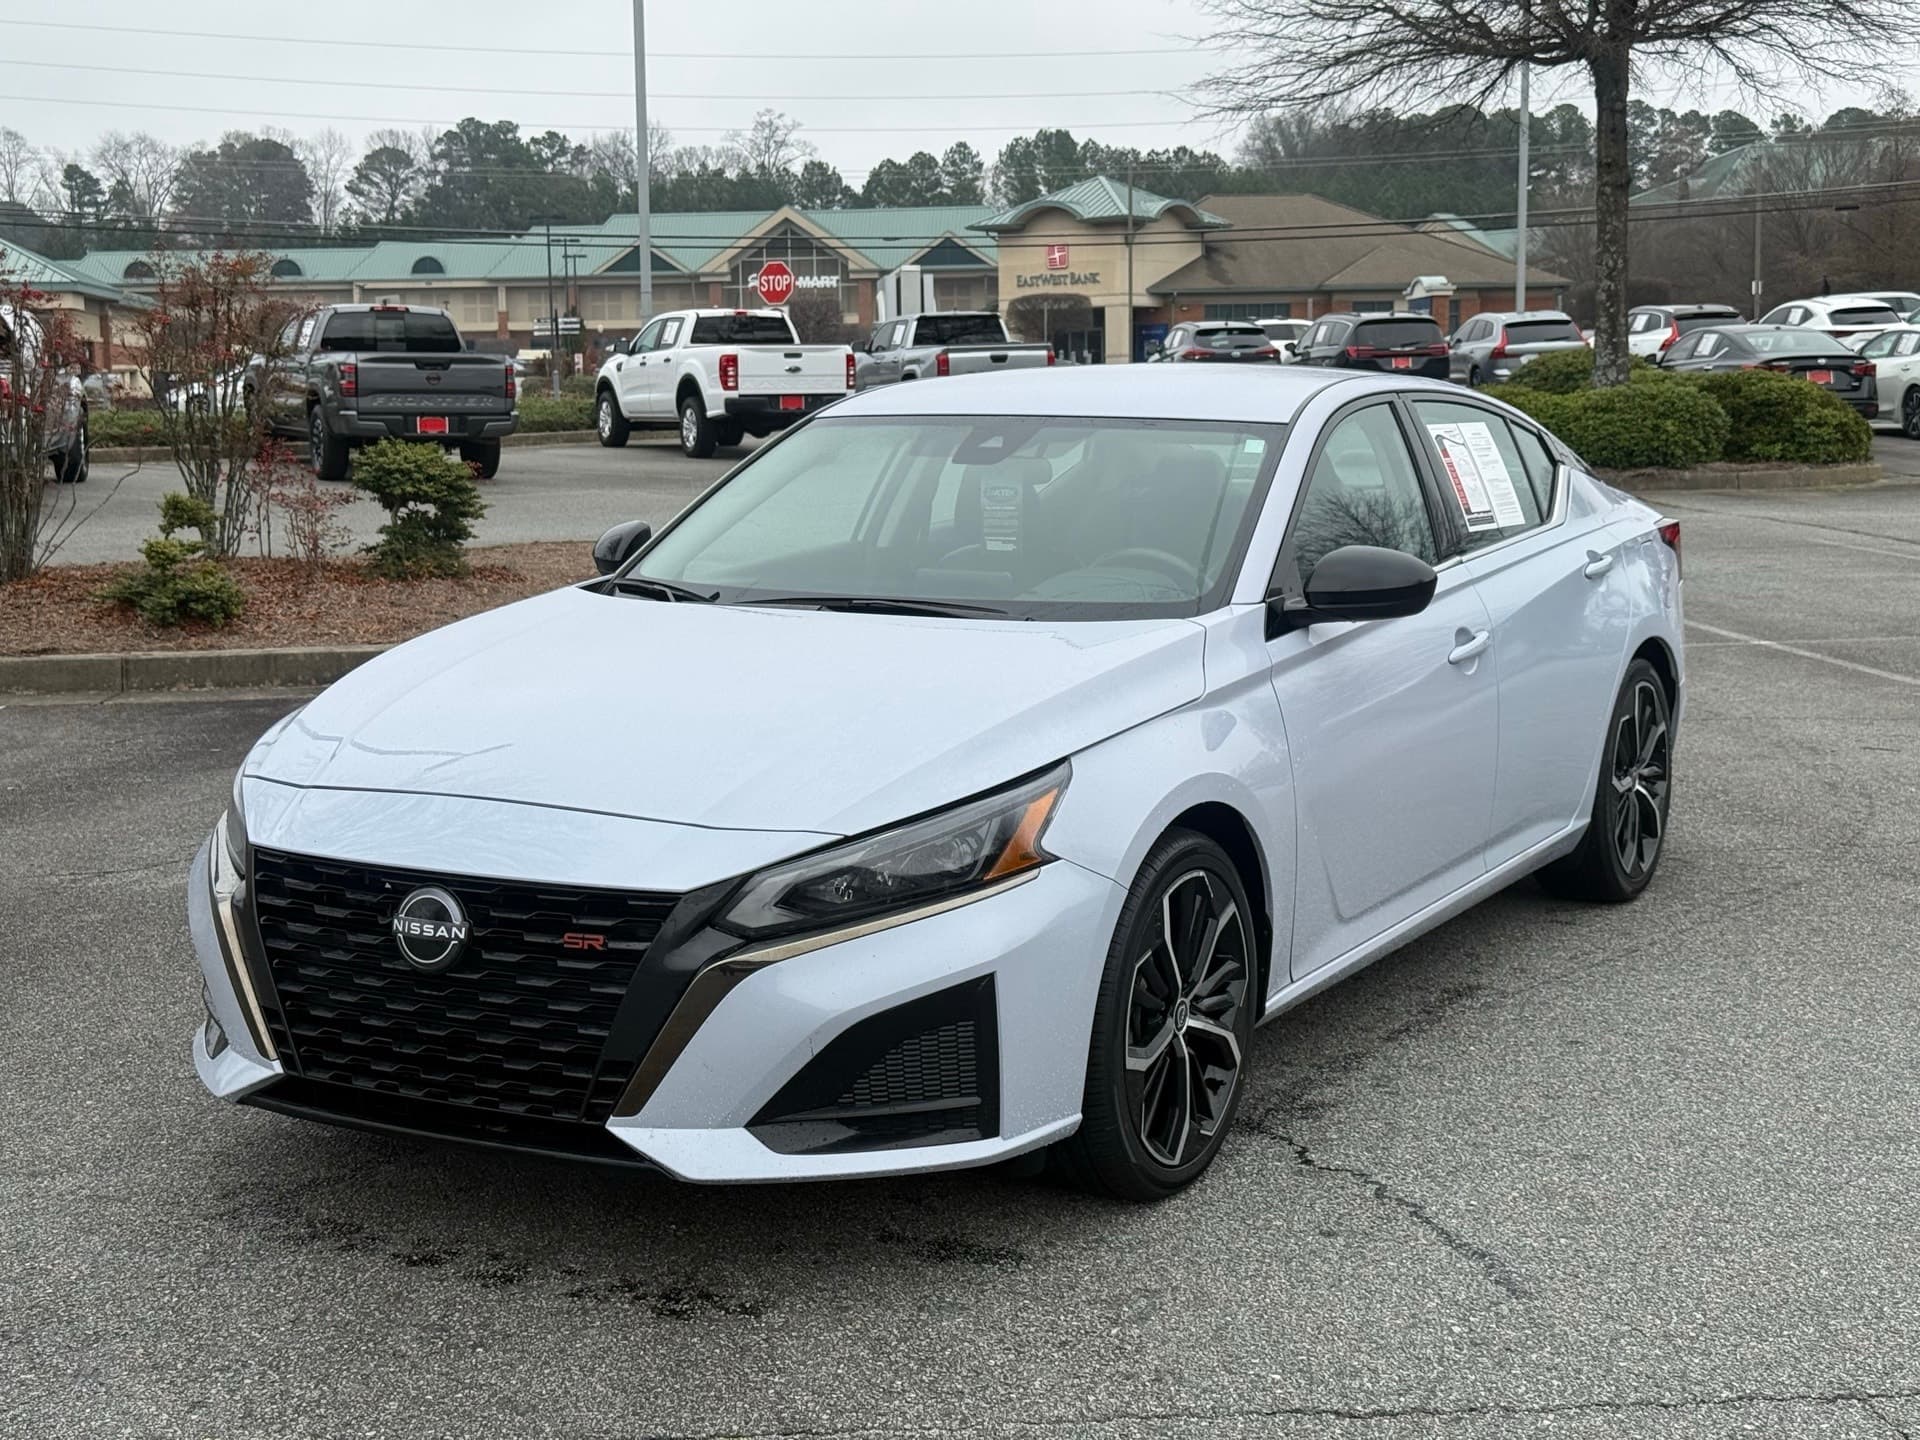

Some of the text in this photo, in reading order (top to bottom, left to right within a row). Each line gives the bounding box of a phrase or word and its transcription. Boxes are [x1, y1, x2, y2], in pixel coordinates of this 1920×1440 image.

[760, 275, 791, 292] STOP
[1069, 272, 1101, 286] BANK
[393, 918, 466, 939] NISSAN
[563, 932, 605, 950] SR
